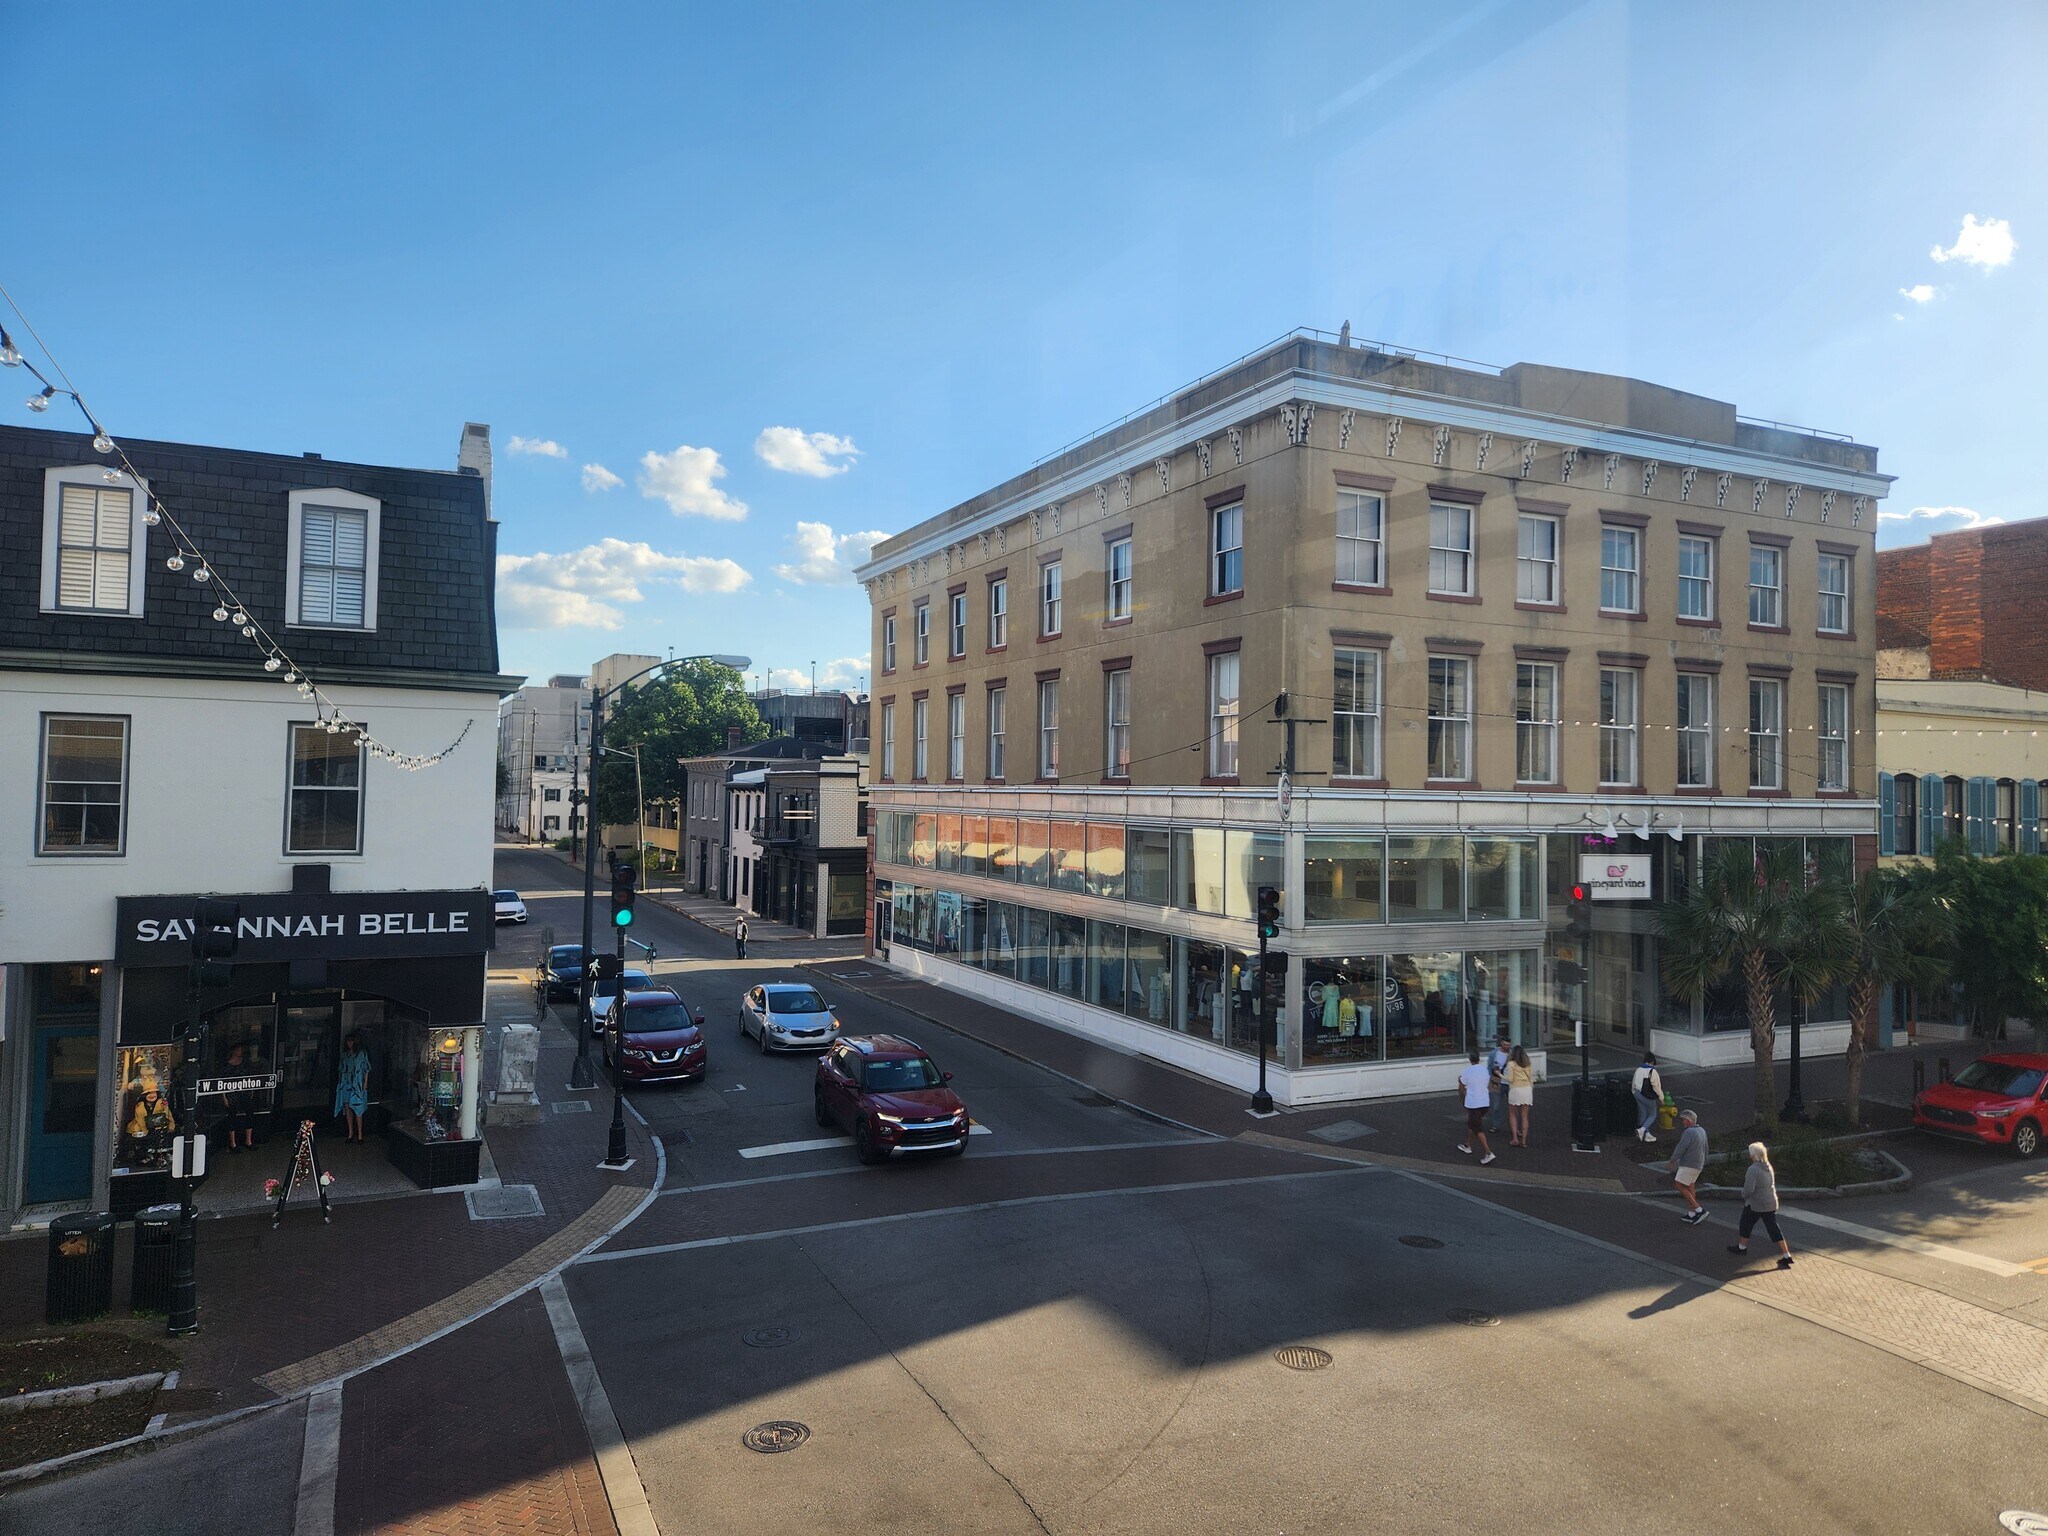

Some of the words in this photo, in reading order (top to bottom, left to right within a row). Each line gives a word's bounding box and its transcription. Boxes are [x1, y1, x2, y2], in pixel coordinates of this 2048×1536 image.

[1624, 878, 1646, 888] vines
[358, 911, 469, 935] BELLE
[202, 1081, 213, 1092] W.
[217, 1078, 261, 1091] Broughton
